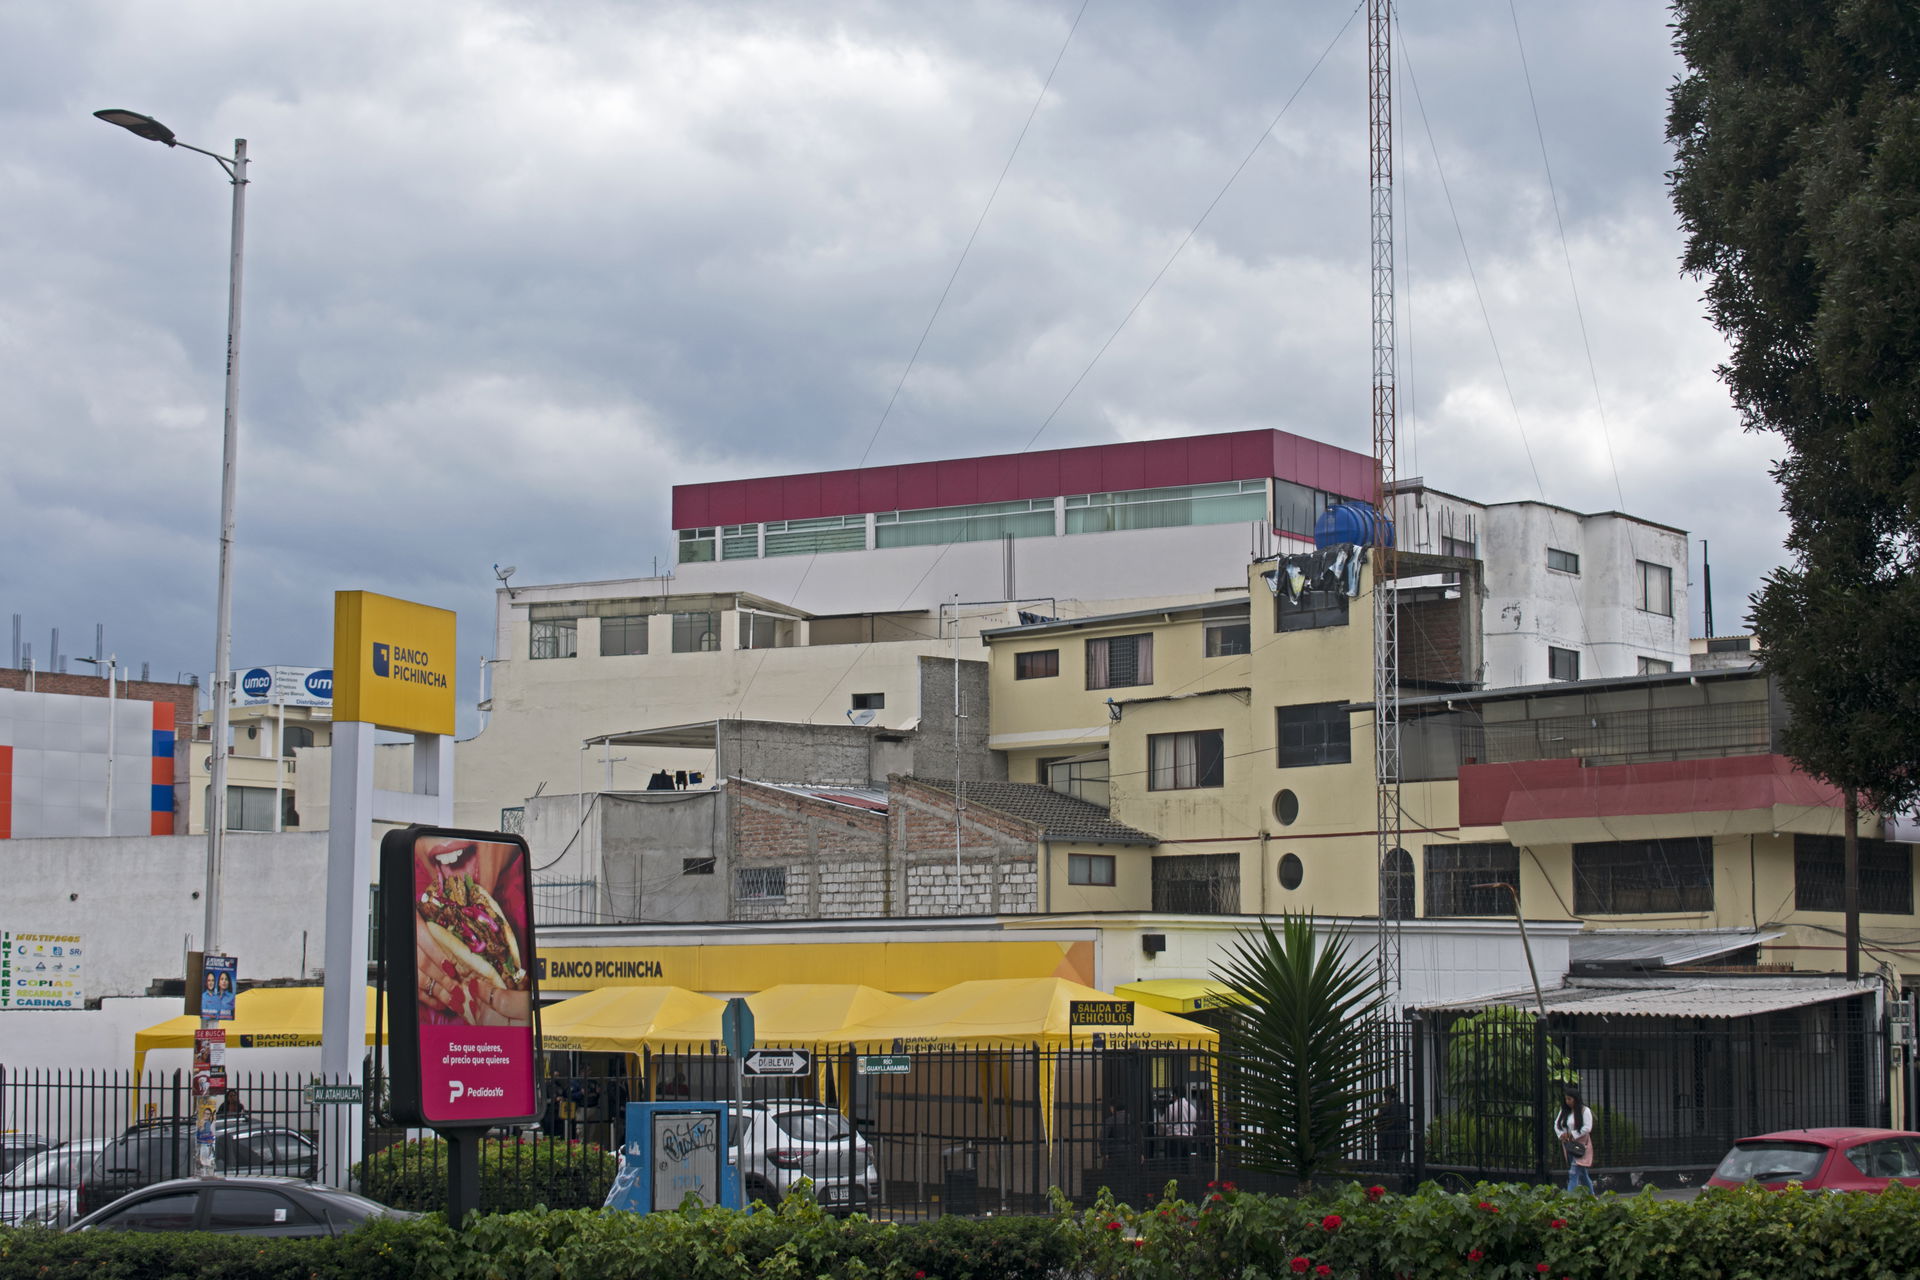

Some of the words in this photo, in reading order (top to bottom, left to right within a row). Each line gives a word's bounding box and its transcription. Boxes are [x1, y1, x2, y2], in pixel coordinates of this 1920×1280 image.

[394, 646, 428, 666] BANCO
[394, 665, 447, 688] PICHINCHA
[244, 677, 270, 689] umco
[16, 934, 81, 943] MULTIPAGOS
[1, 931, 12, 1007] INTERNET
[551, 961, 592, 978] BANCO
[595, 961, 663, 978] PICHINCHA
[17, 979, 74, 987] COPIAS
[16, 989, 63, 998] RECARGAS
[16, 999, 72, 1007] CABINAS
[1078, 1003, 1111, 1012] SALIDA
[1115, 1003, 1127, 1012] DE
[1072, 1013, 1132, 1023] VEHICULOS
[256, 1040, 323, 1048] PICHINCHA
[449, 1042, 462, 1052] Eso
[463, 1045, 475, 1053] que
[477, 1042, 502, 1053] quieres,
[904, 1042, 956, 1052] PICHNCHA
[442, 1054, 449, 1064] al
[451, 1054, 471, 1066] precio
[472, 1057, 484, 1066] que
[486, 1055, 509, 1066] quieres
[783, 1058, 794, 1067] VIA
[315, 1089, 324, 1100] AV.
[325, 1089, 360, 1100] ATAHUALPA
[467, 1087, 503, 1097] PedidosYa
